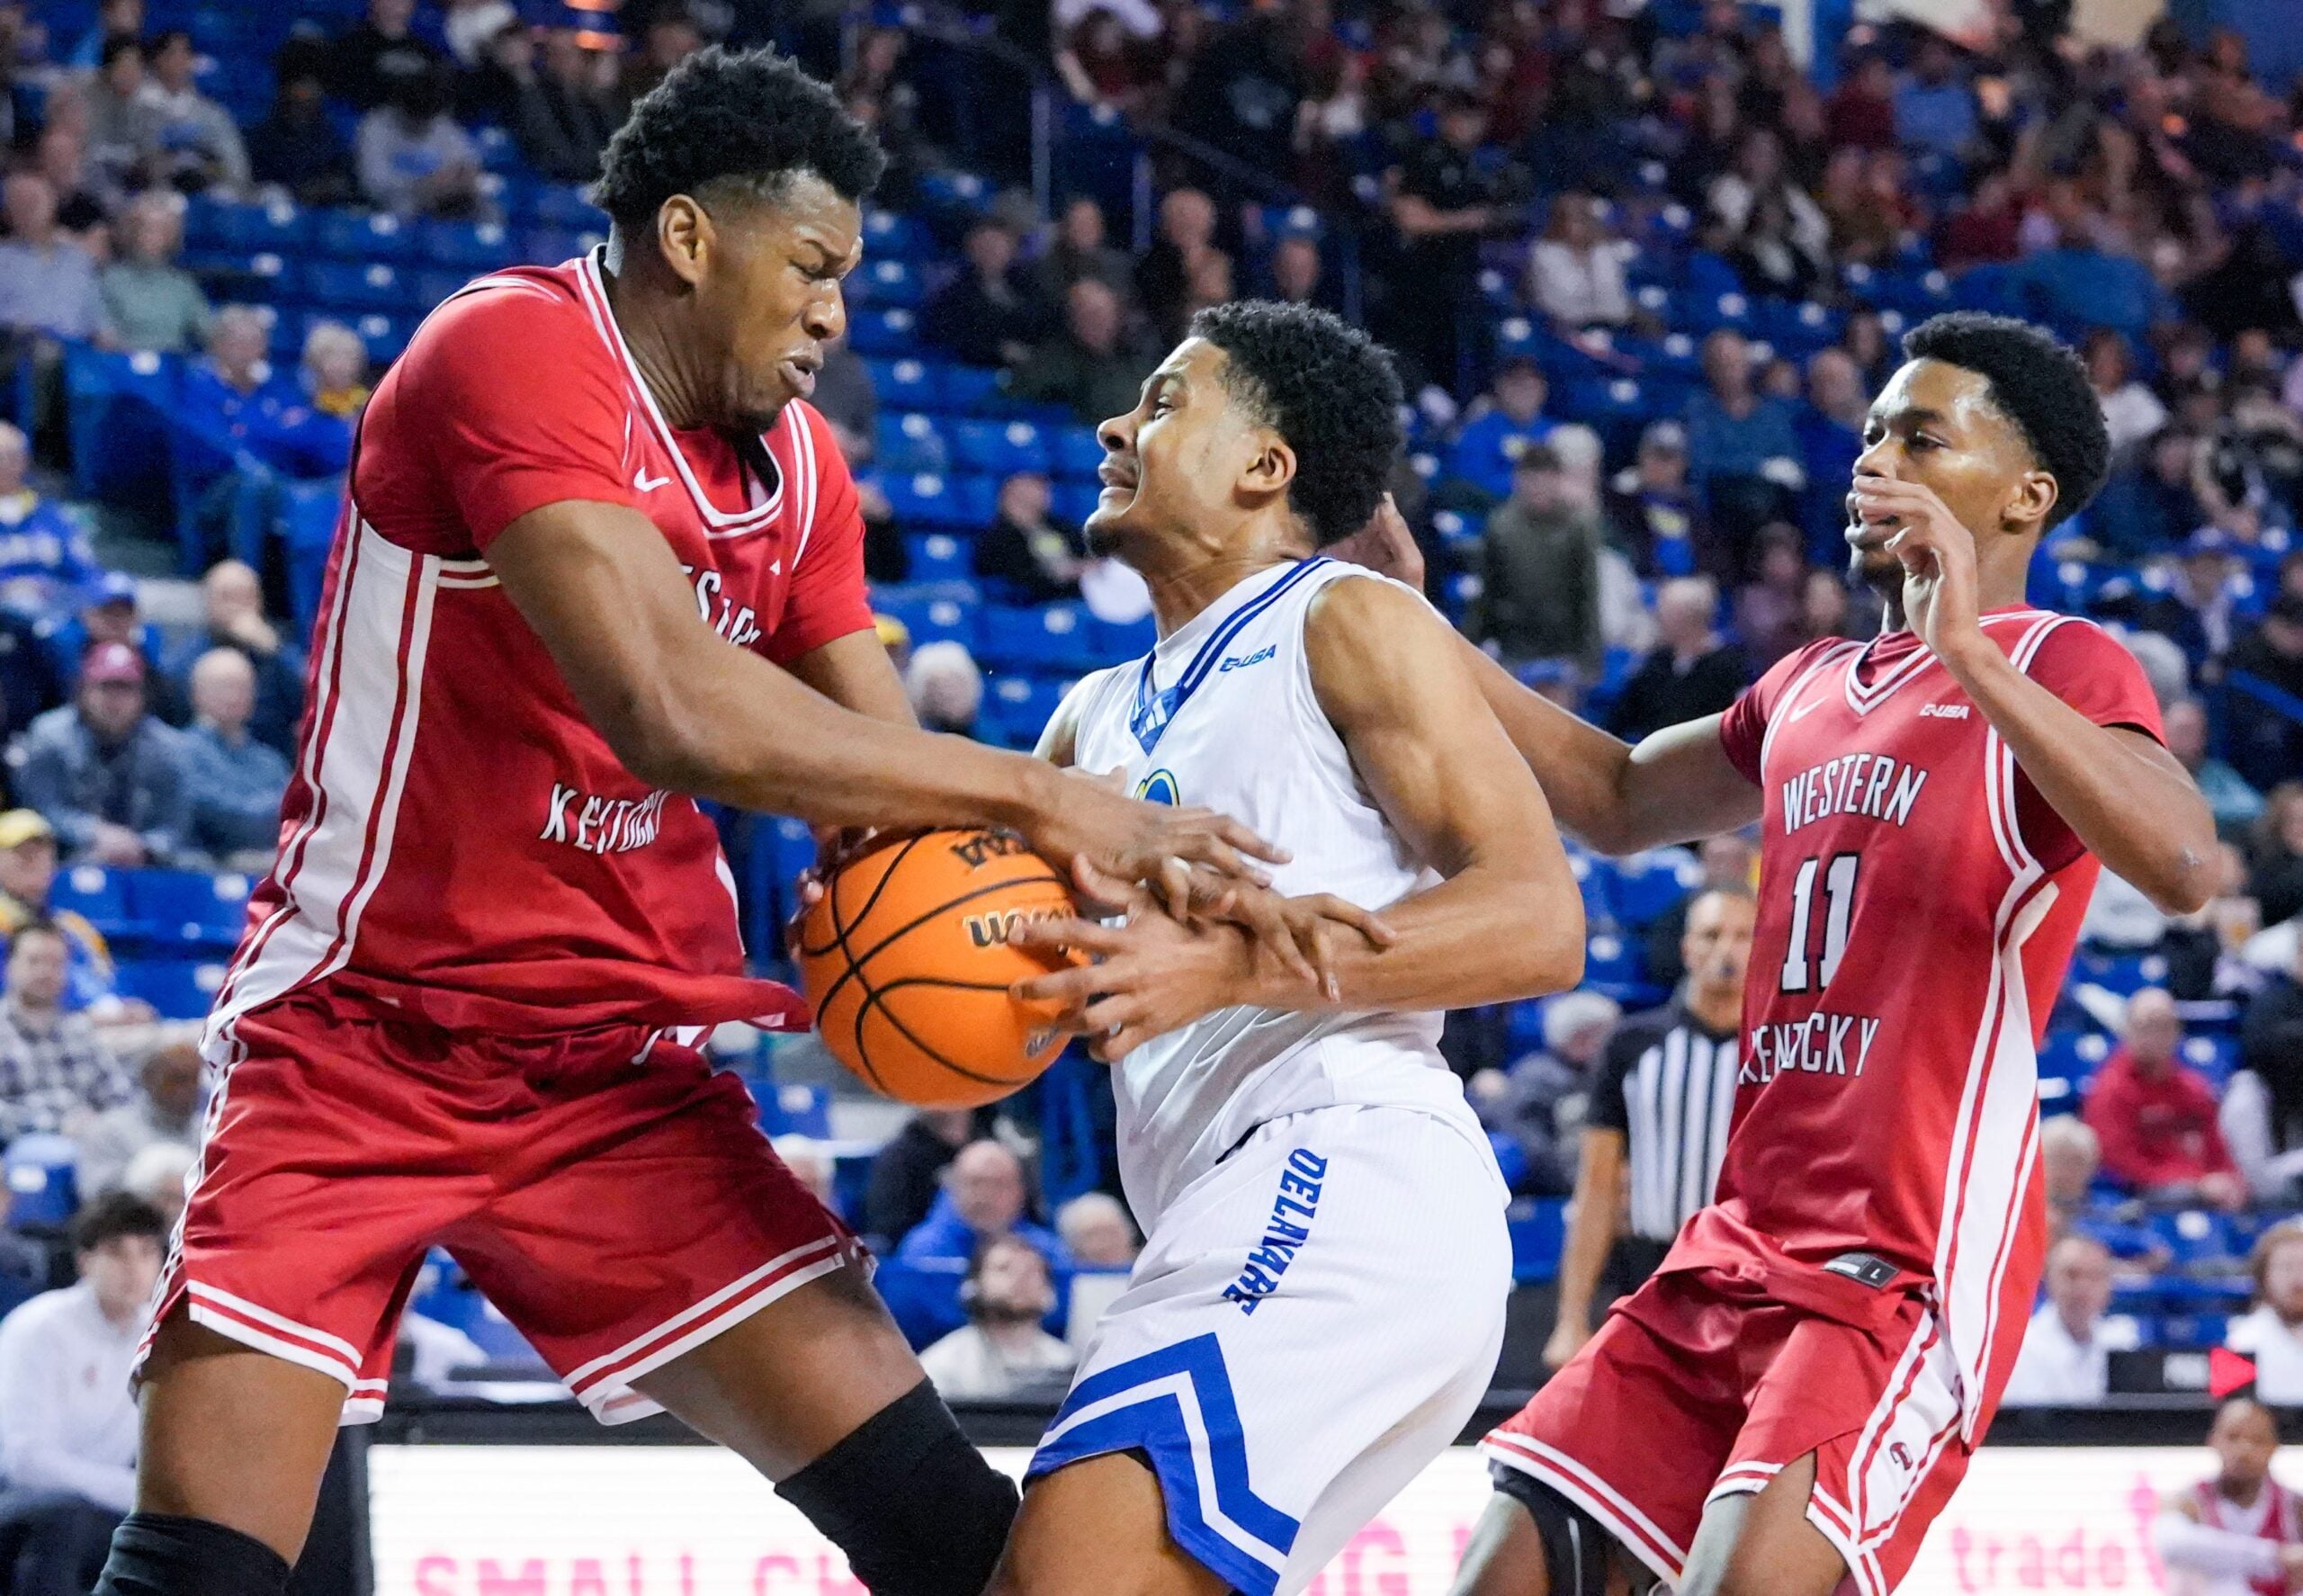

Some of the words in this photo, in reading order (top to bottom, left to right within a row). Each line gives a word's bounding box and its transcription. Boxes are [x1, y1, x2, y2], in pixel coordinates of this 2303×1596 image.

[1782, 752, 1930, 836] WESTERN
[1780, 850, 1861, 995] 11
[1220, 1147, 1329, 1317] DELAWARE
